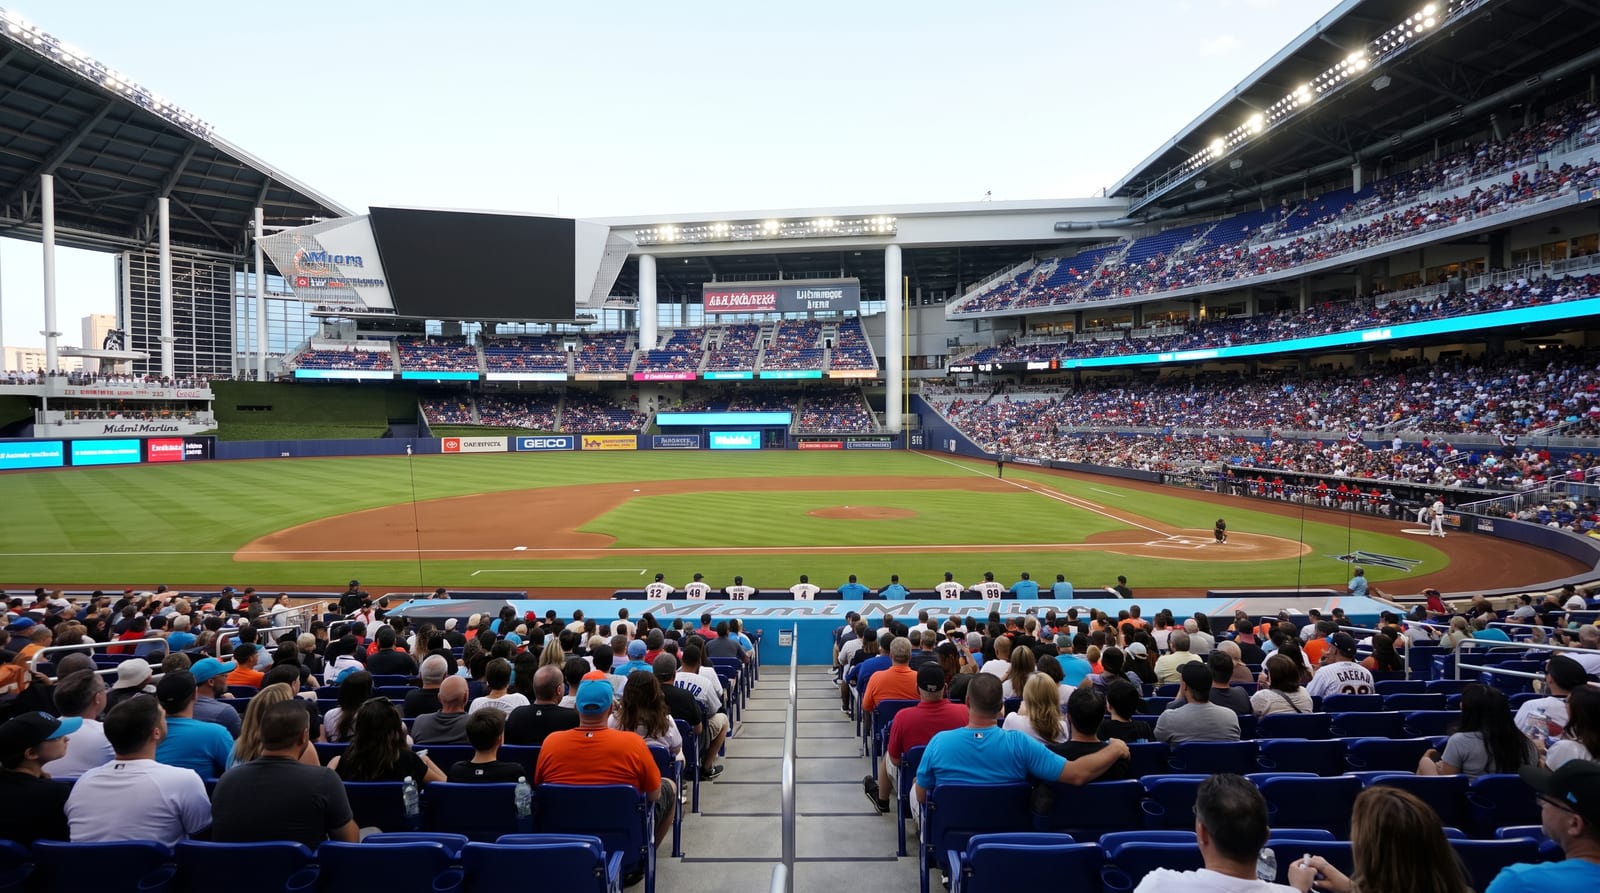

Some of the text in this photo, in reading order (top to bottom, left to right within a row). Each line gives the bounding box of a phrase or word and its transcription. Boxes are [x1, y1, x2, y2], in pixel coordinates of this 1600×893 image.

[140, 424, 179, 433] Marlins
[524, 439, 567, 449] GEICO
[945, 589, 958, 599] 34
[642, 602, 843, 616] Miami
